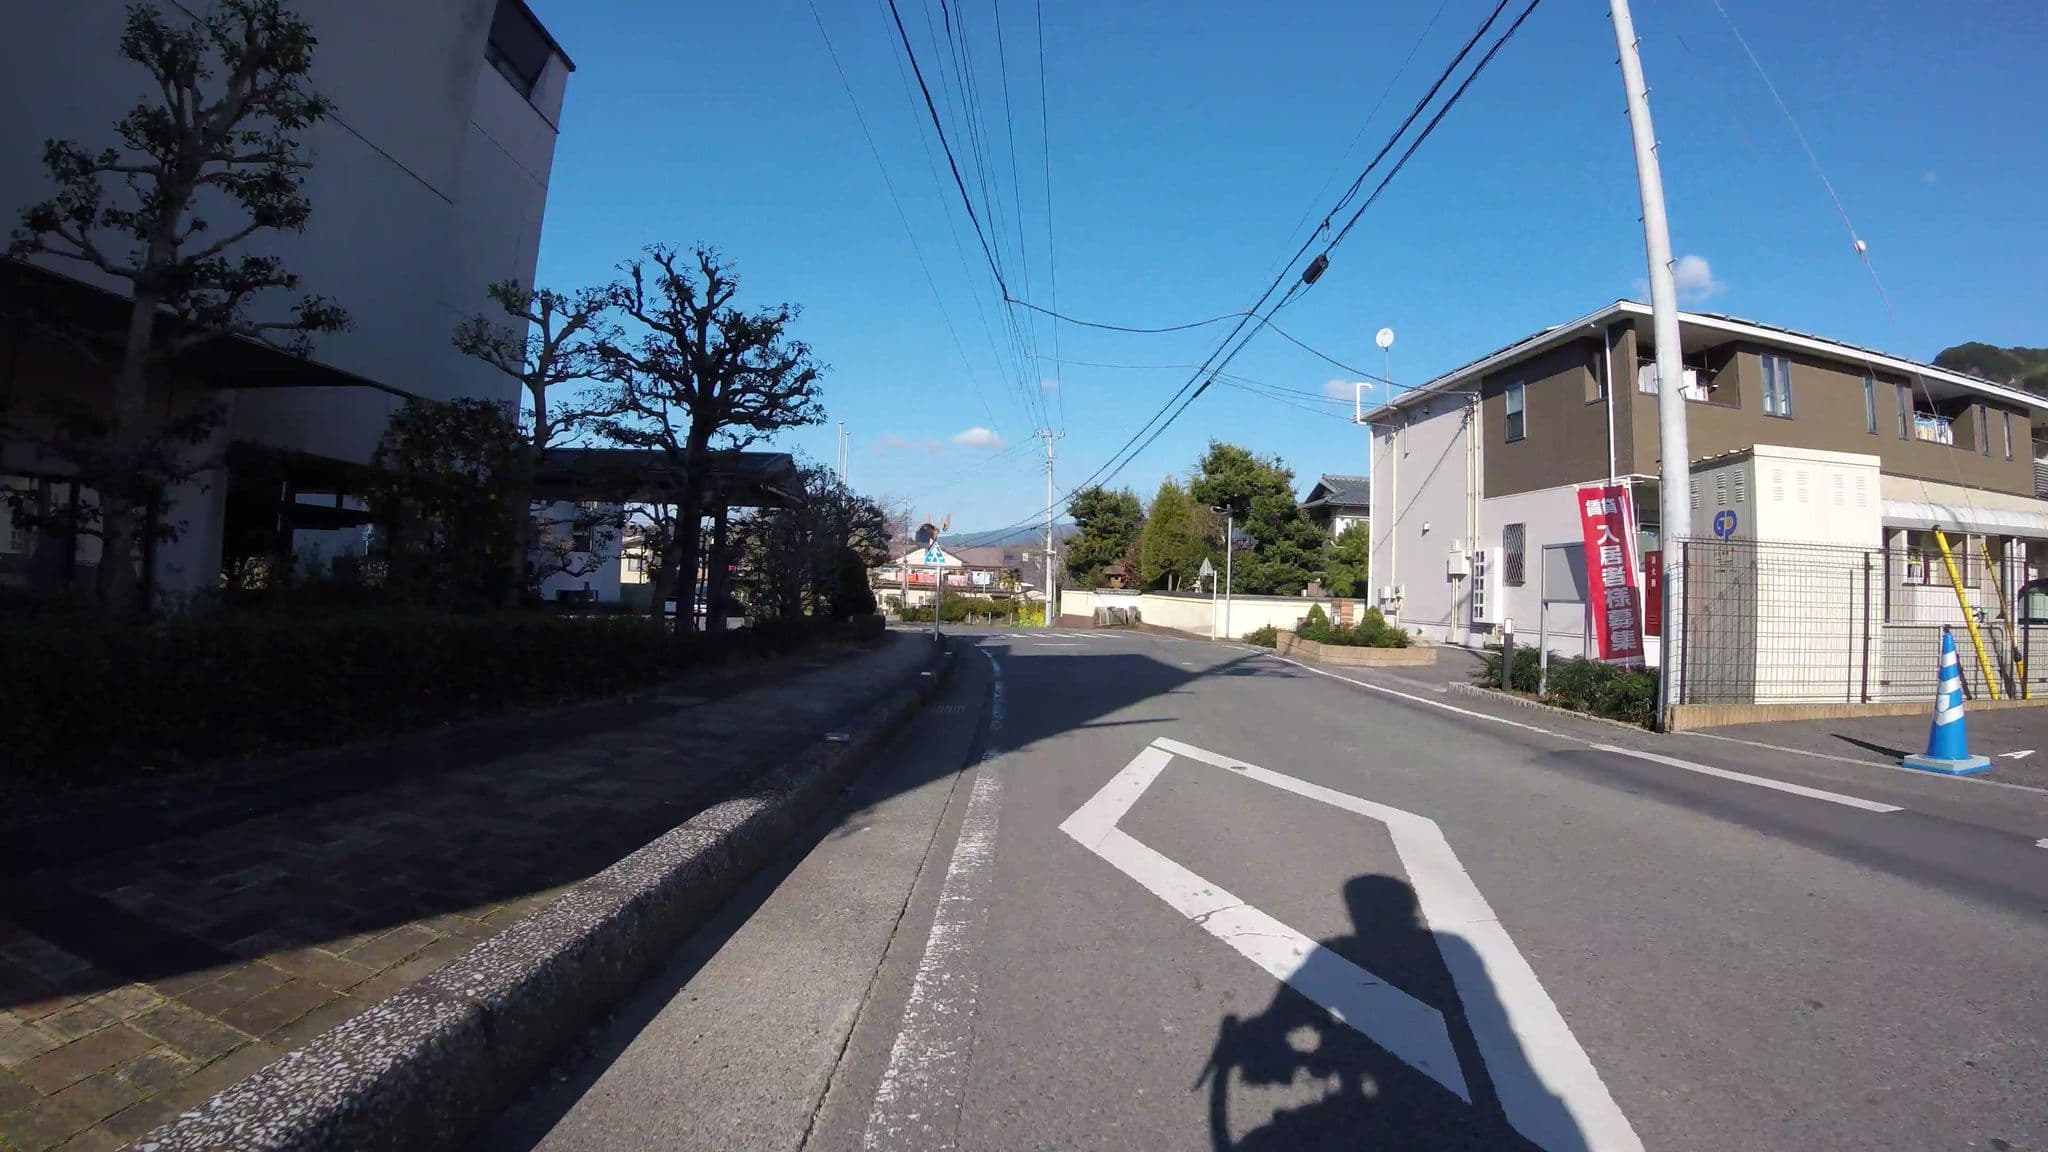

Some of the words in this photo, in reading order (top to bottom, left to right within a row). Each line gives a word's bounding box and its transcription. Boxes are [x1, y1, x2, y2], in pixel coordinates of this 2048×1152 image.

[1595, 524, 1637, 651] 入居者様募集
